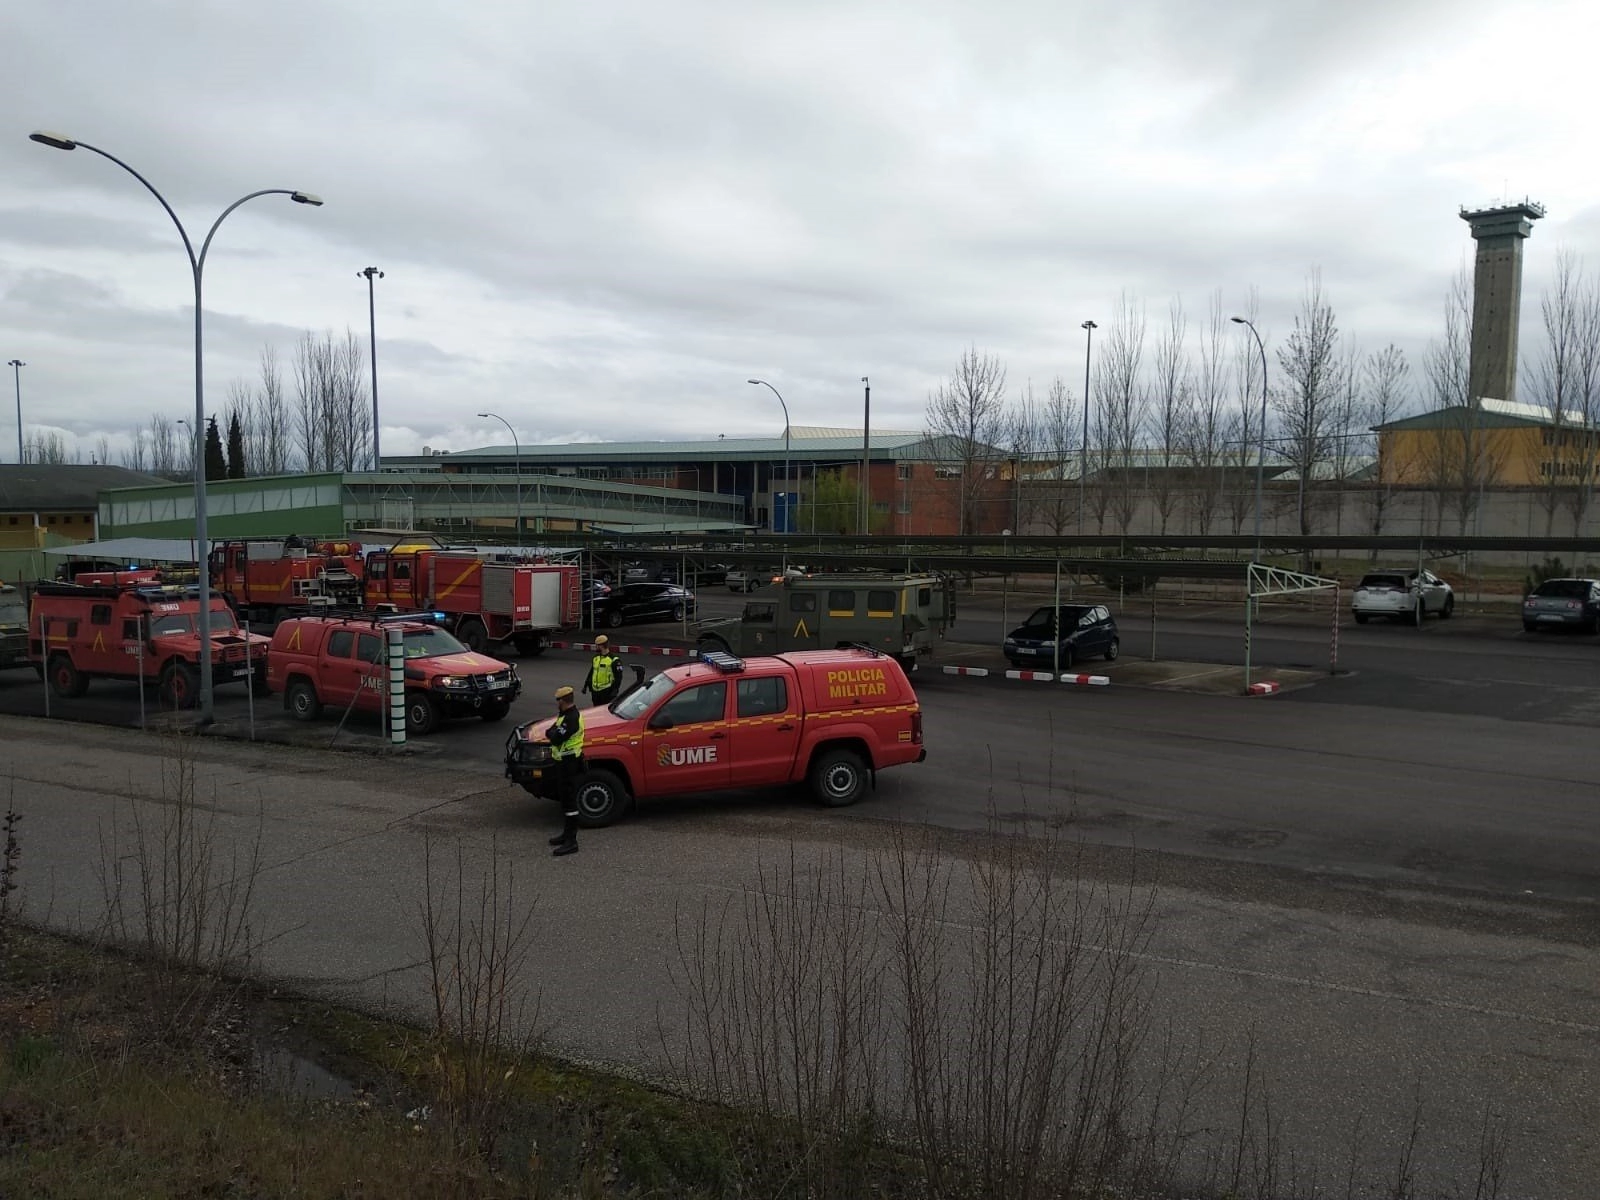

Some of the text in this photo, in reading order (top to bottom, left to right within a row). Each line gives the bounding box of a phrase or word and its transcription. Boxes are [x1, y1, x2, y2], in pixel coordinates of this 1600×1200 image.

[827, 668, 885, 684] POLICIA
[829, 682, 887, 699] MILITAR
[671, 747, 718, 766] UME
